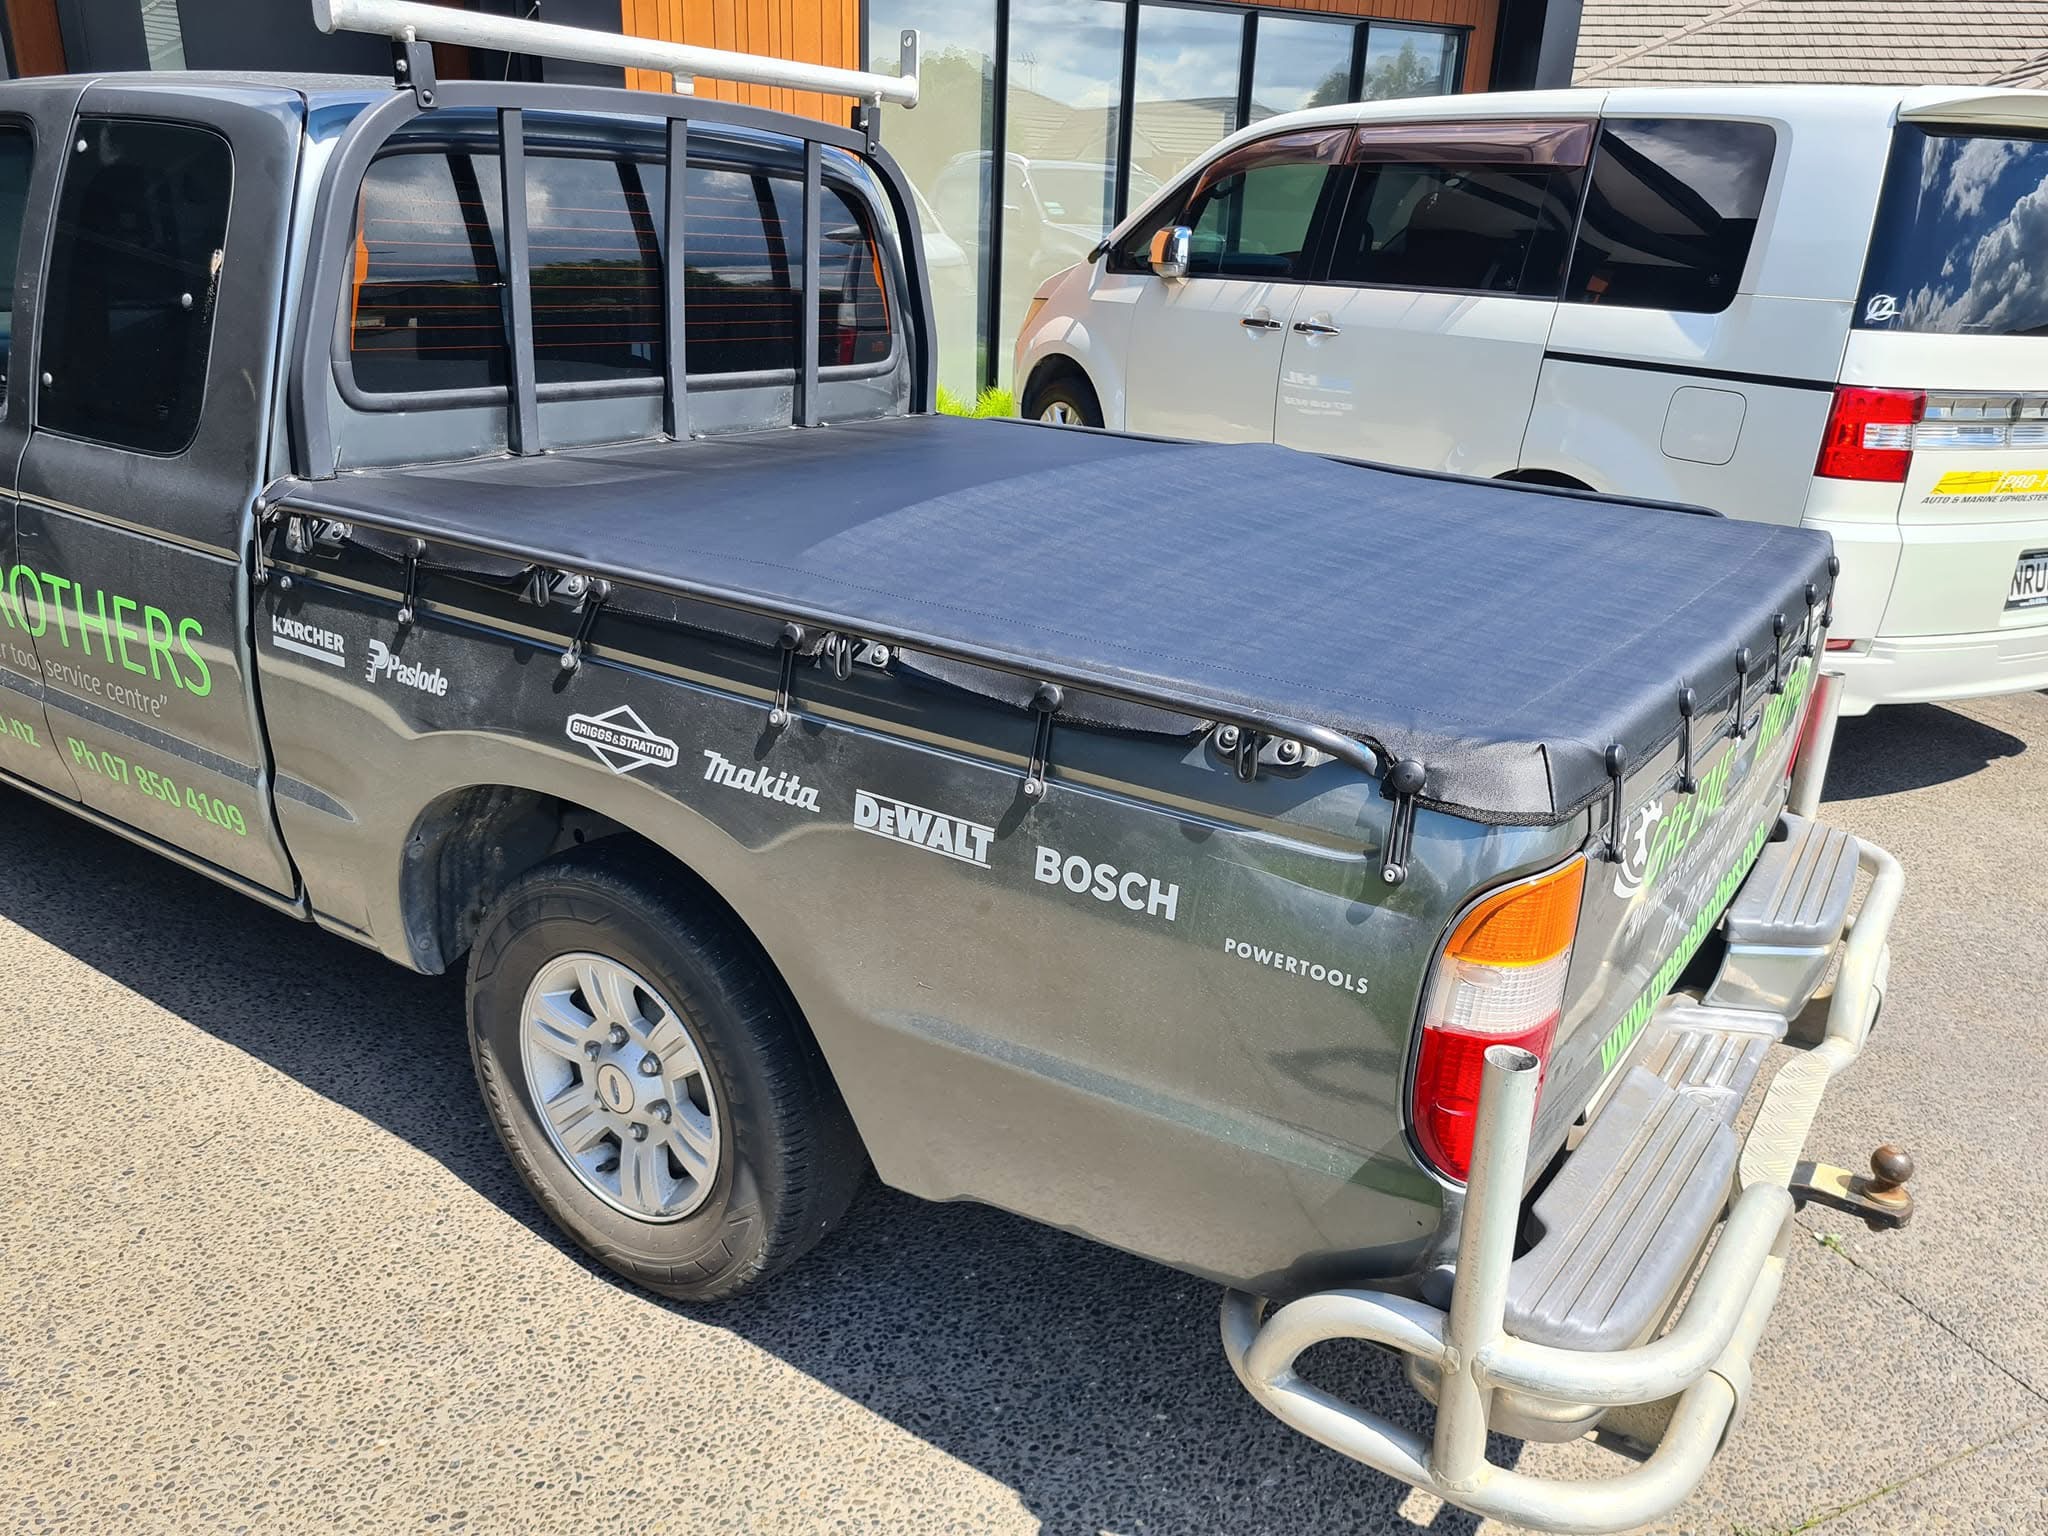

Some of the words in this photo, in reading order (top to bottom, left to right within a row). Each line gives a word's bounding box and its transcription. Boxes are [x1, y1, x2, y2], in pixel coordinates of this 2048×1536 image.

[1921, 496, 1951, 504] AUTO
[1960, 495, 1999, 503] MARINE
[45, 659, 102, 695] service
[386, 654, 449, 697] Paslode
[67, 736, 101, 774] Ph
[102, 751, 129, 785] 07
[134, 765, 182, 808] 850
[186, 787, 247, 836] 4109
[1643, 744, 1736, 889] GREENE
[1034, 845, 1180, 922] BOSCH
[1224, 937, 1370, 995] POWERTOOLS
